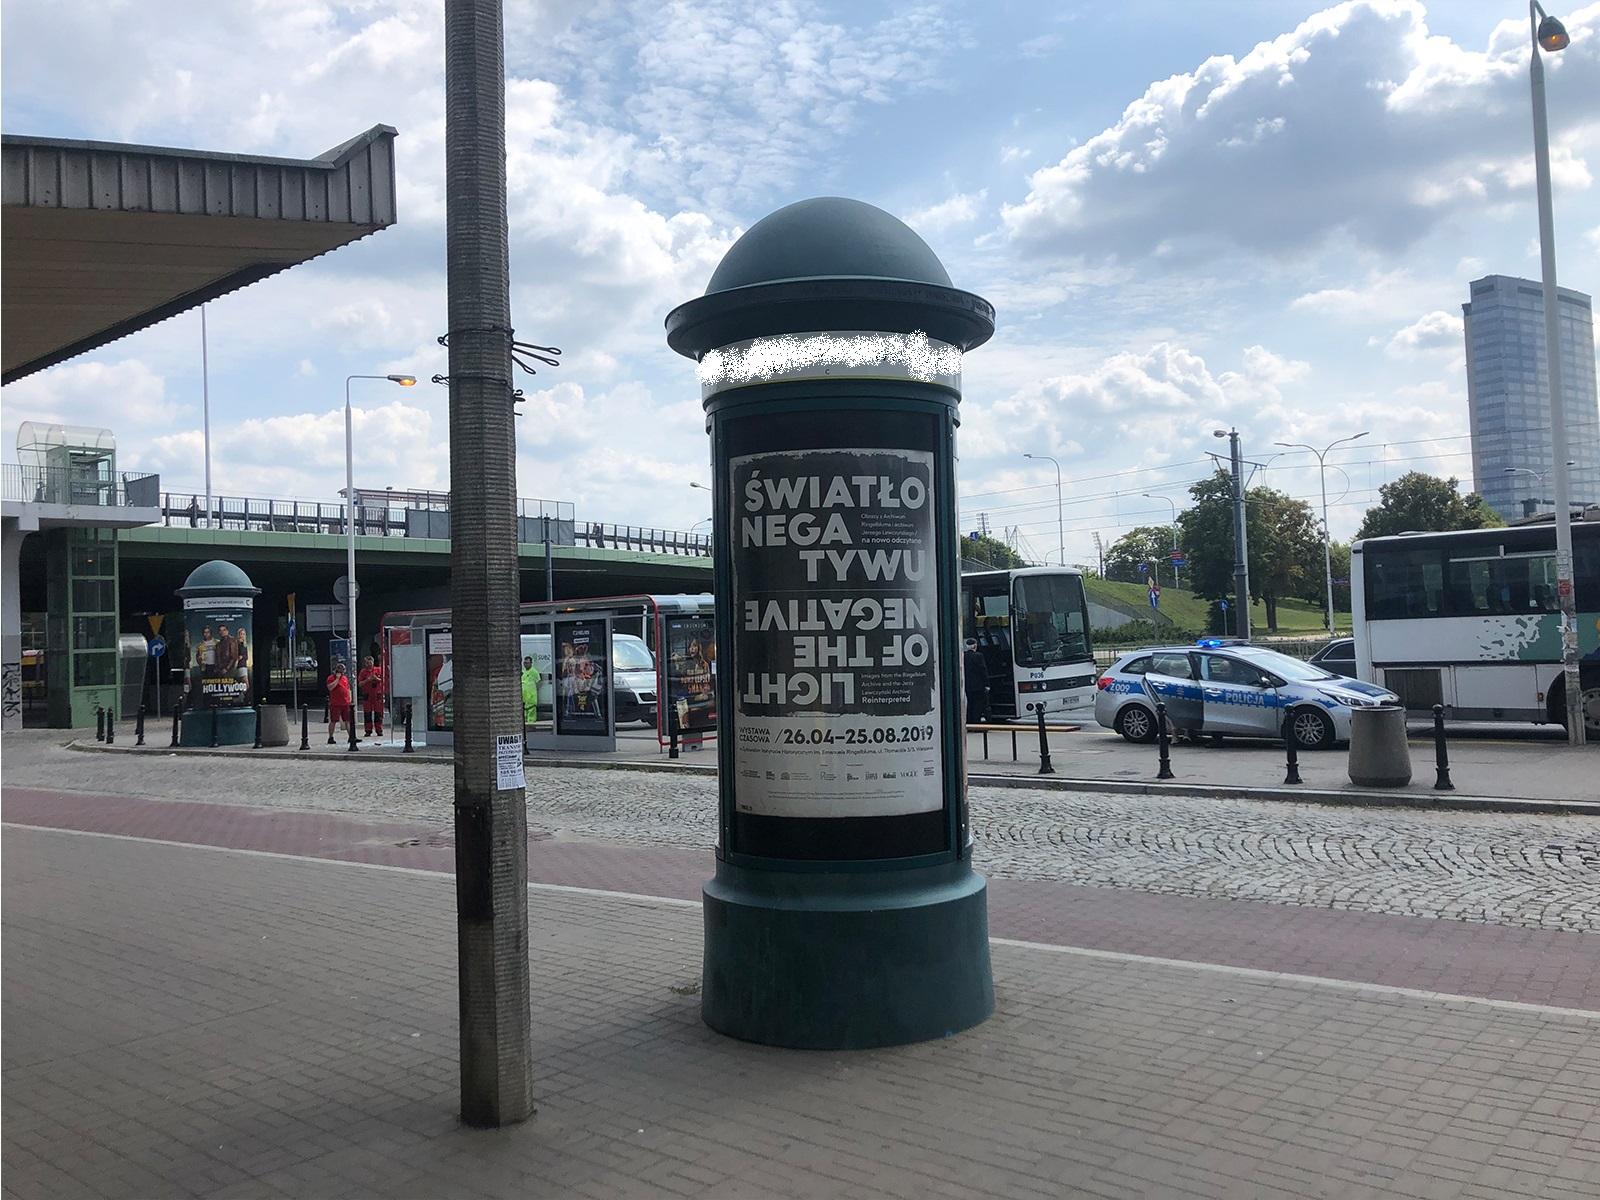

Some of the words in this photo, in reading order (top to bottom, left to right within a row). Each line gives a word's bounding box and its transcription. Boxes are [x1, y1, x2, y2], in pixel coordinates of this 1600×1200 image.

[744, 470, 926, 512] ŚWIATŁO
[741, 513, 853, 548] NEGA
[799, 550, 926, 582] TYWU
[744, 597, 928, 631] NEGATIVE
[793, 635, 874, 668] THE
[882, 633, 929, 667] OF
[202, 682, 247, 693] HOLLYWOOD
[743, 672, 855, 706] LIGHT
[861, 694, 911, 705] Reinterpreted
[1225, 692, 1265, 706] POLICJA
[739, 726, 770, 735] WYSTAWA
[739, 734, 770, 743] CZASOWA
